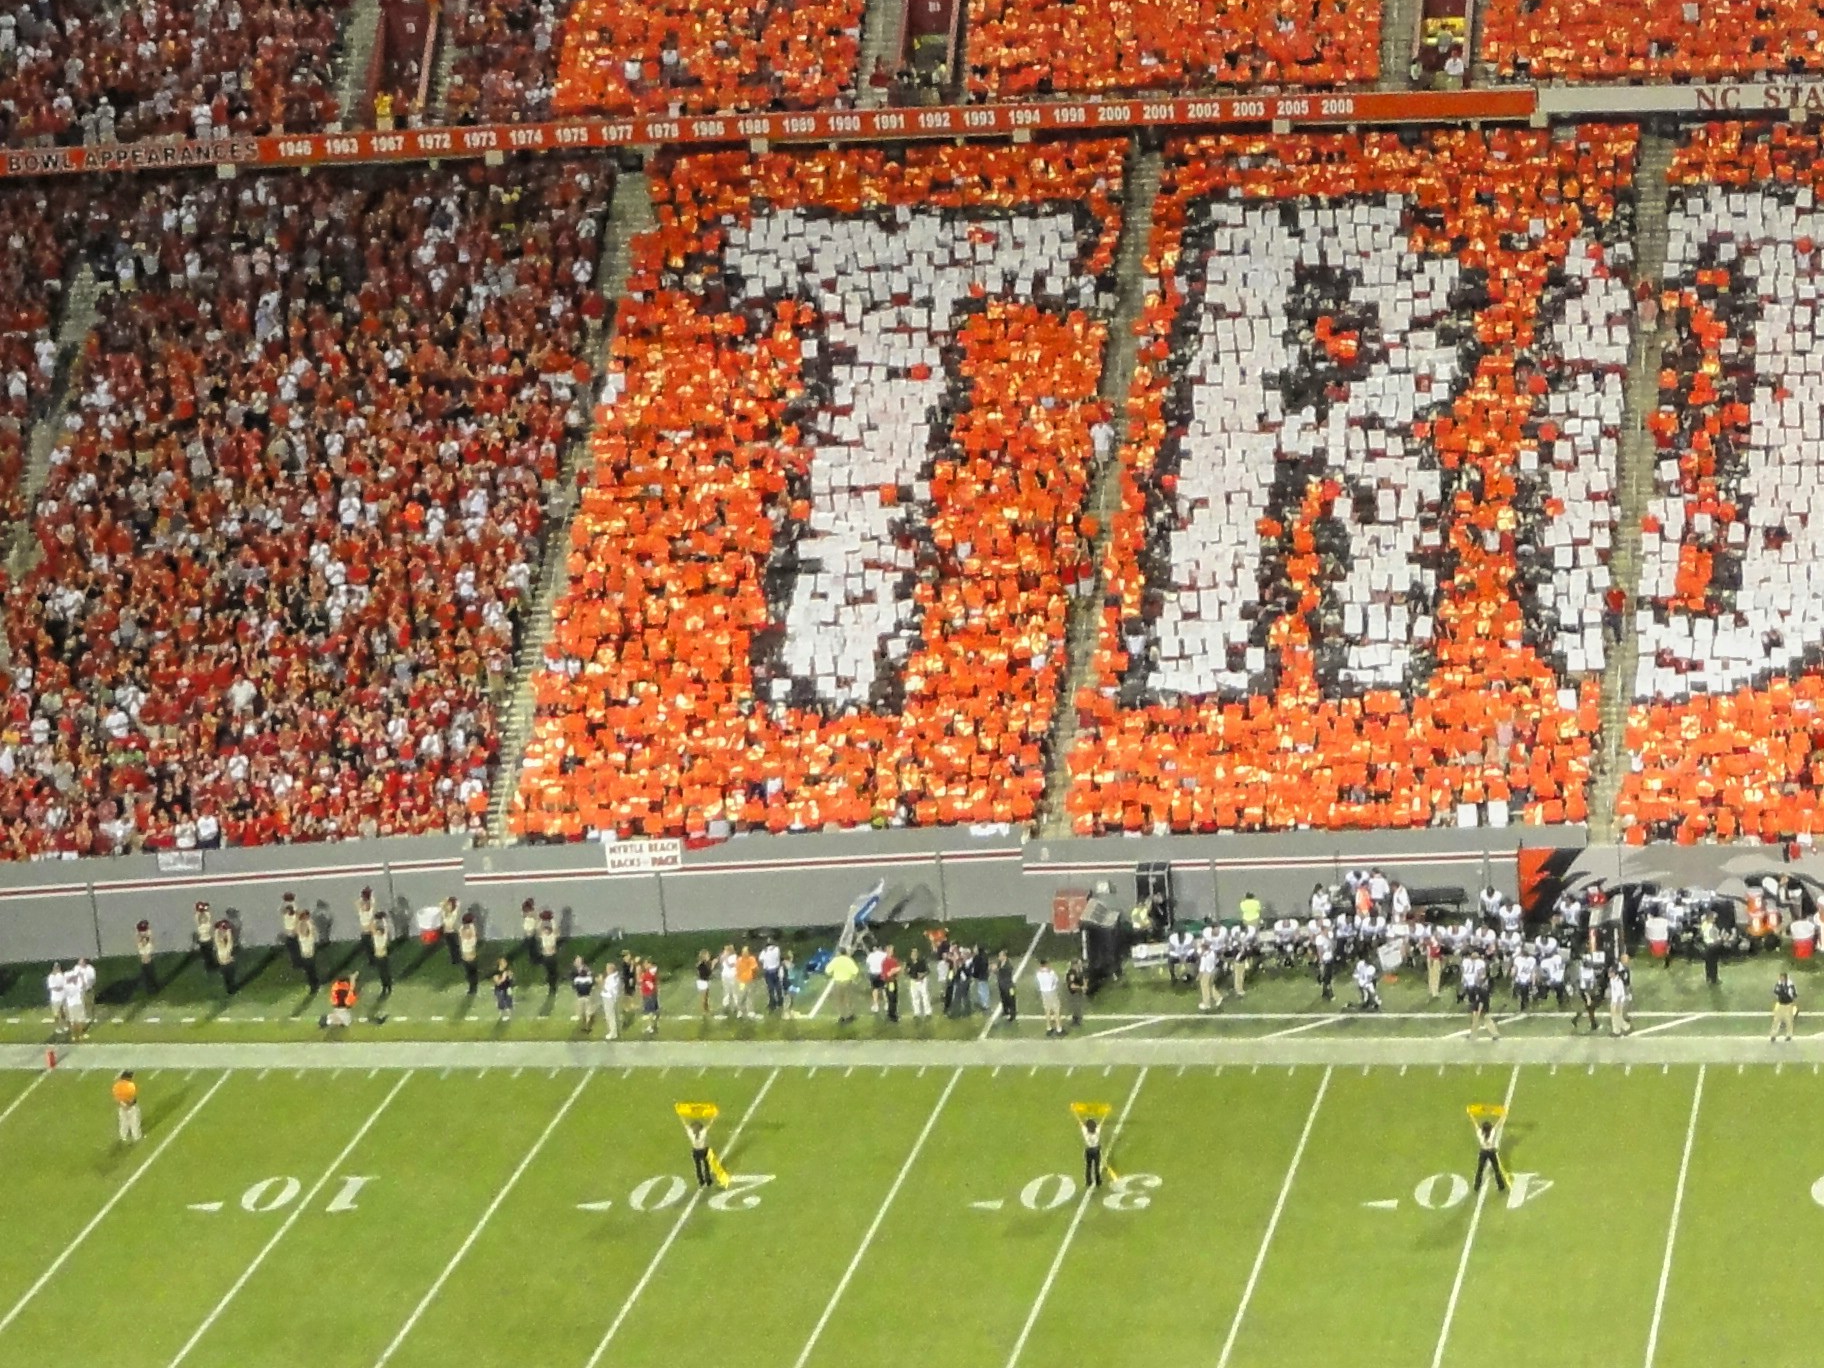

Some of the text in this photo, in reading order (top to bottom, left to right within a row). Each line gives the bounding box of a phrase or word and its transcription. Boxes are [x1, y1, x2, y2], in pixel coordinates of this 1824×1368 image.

[1696, 88, 1740, 110] NC
[417, 133, 450, 149] 1972
[463, 131, 497, 147] 1973
[509, 129, 543, 145] 1974
[555, 127, 589, 142] 1975
[601, 125, 633, 141] 1977
[873, 114, 905, 129] 1991
[918, 112, 950, 128] 1992
[963, 110, 995, 126] 1993
[1008, 108, 1041, 125] 1994
[1098, 106, 1130, 121] 2000
[1143, 104, 1174, 119] 2001
[1188, 103, 1220, 118] 2002
[1233, 101, 1265, 117] 2003
[1277, 100, 1309, 115] 2005
[8, 140, 259, 172] BOWL APPEARANCES
